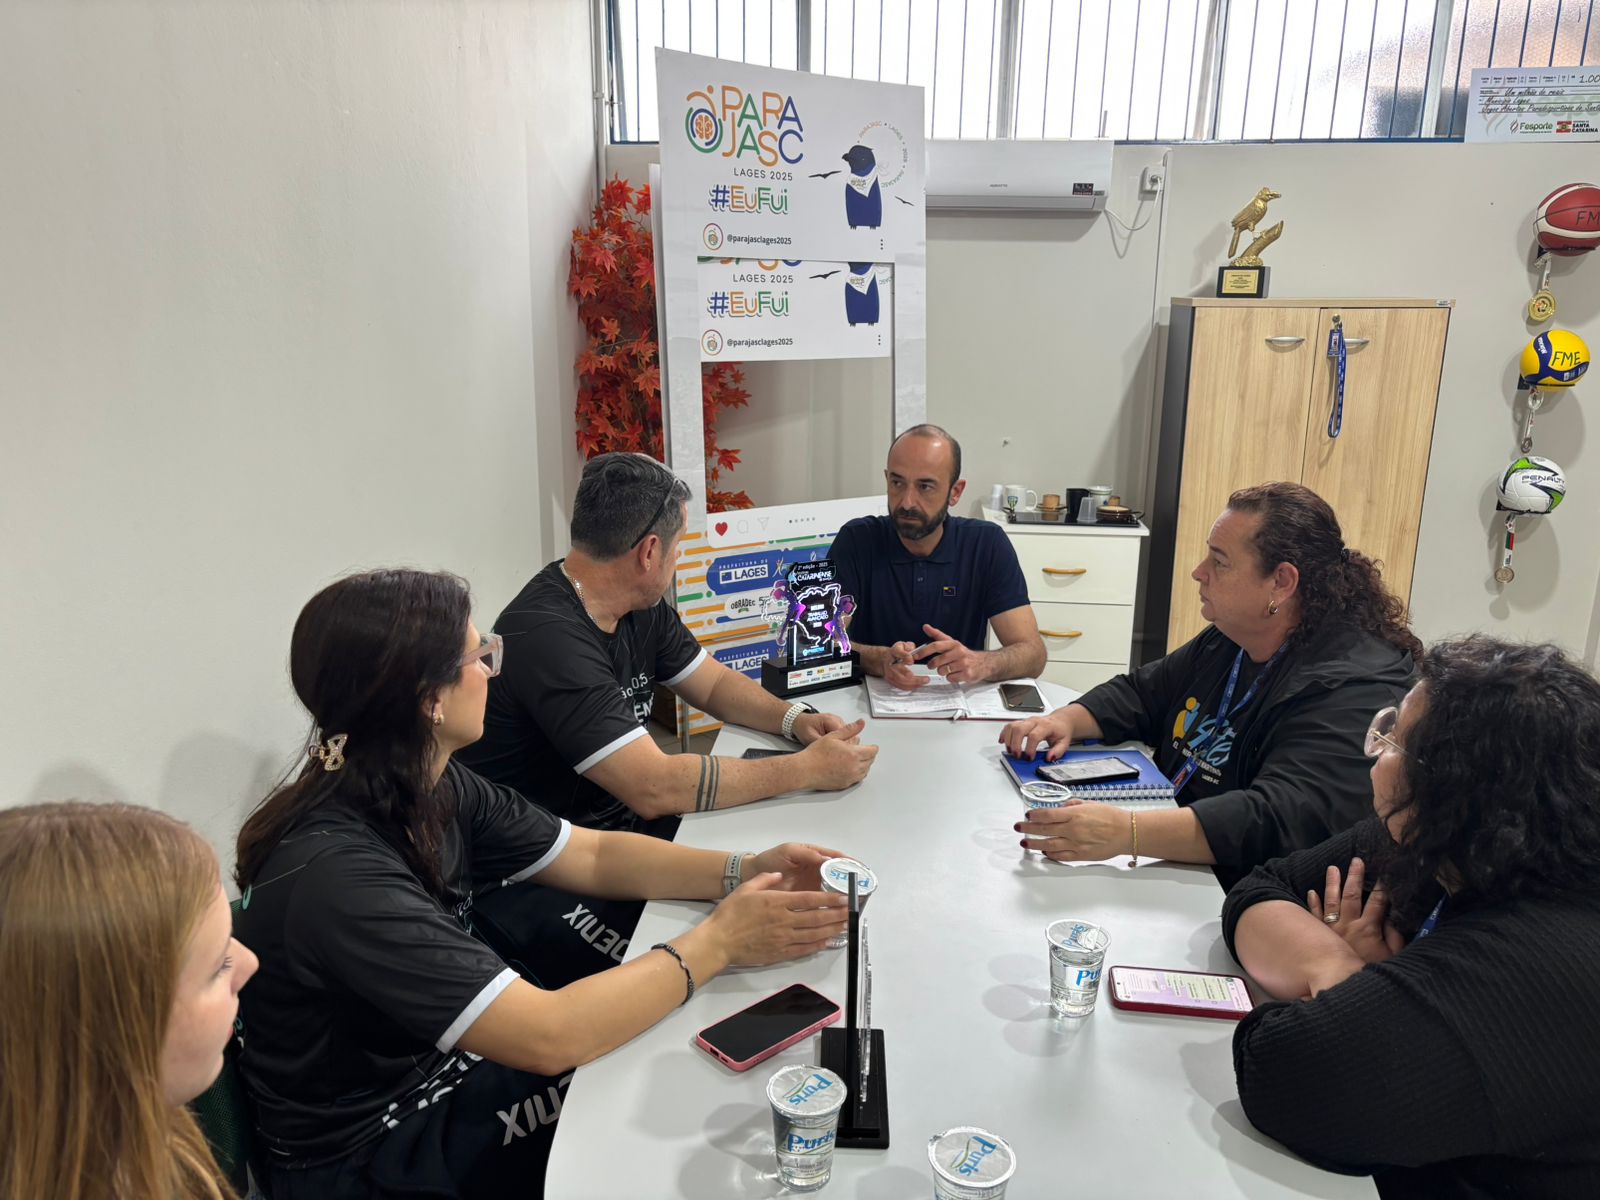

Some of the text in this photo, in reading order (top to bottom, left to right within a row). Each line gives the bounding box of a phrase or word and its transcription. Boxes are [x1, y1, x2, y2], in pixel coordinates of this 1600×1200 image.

[722, 85, 804, 132] PARA
[1520, 121, 1553, 132] Fesporte
[722, 112, 804, 167] JASC
[733, 167, 793, 181] LAGES 2025
[709, 184, 789, 215] #EuFui
[726, 234, 792, 246] @parajasclages2025
[733, 274, 794, 284] LAGES 2025
[707, 291, 789, 318] #EuFui
[726, 337, 793, 348] @parajasclages2025
[1551, 351, 1581, 367] FME
[719, 560, 757, 569] PREFEITURA
[734, 566, 767, 580] LAGES
